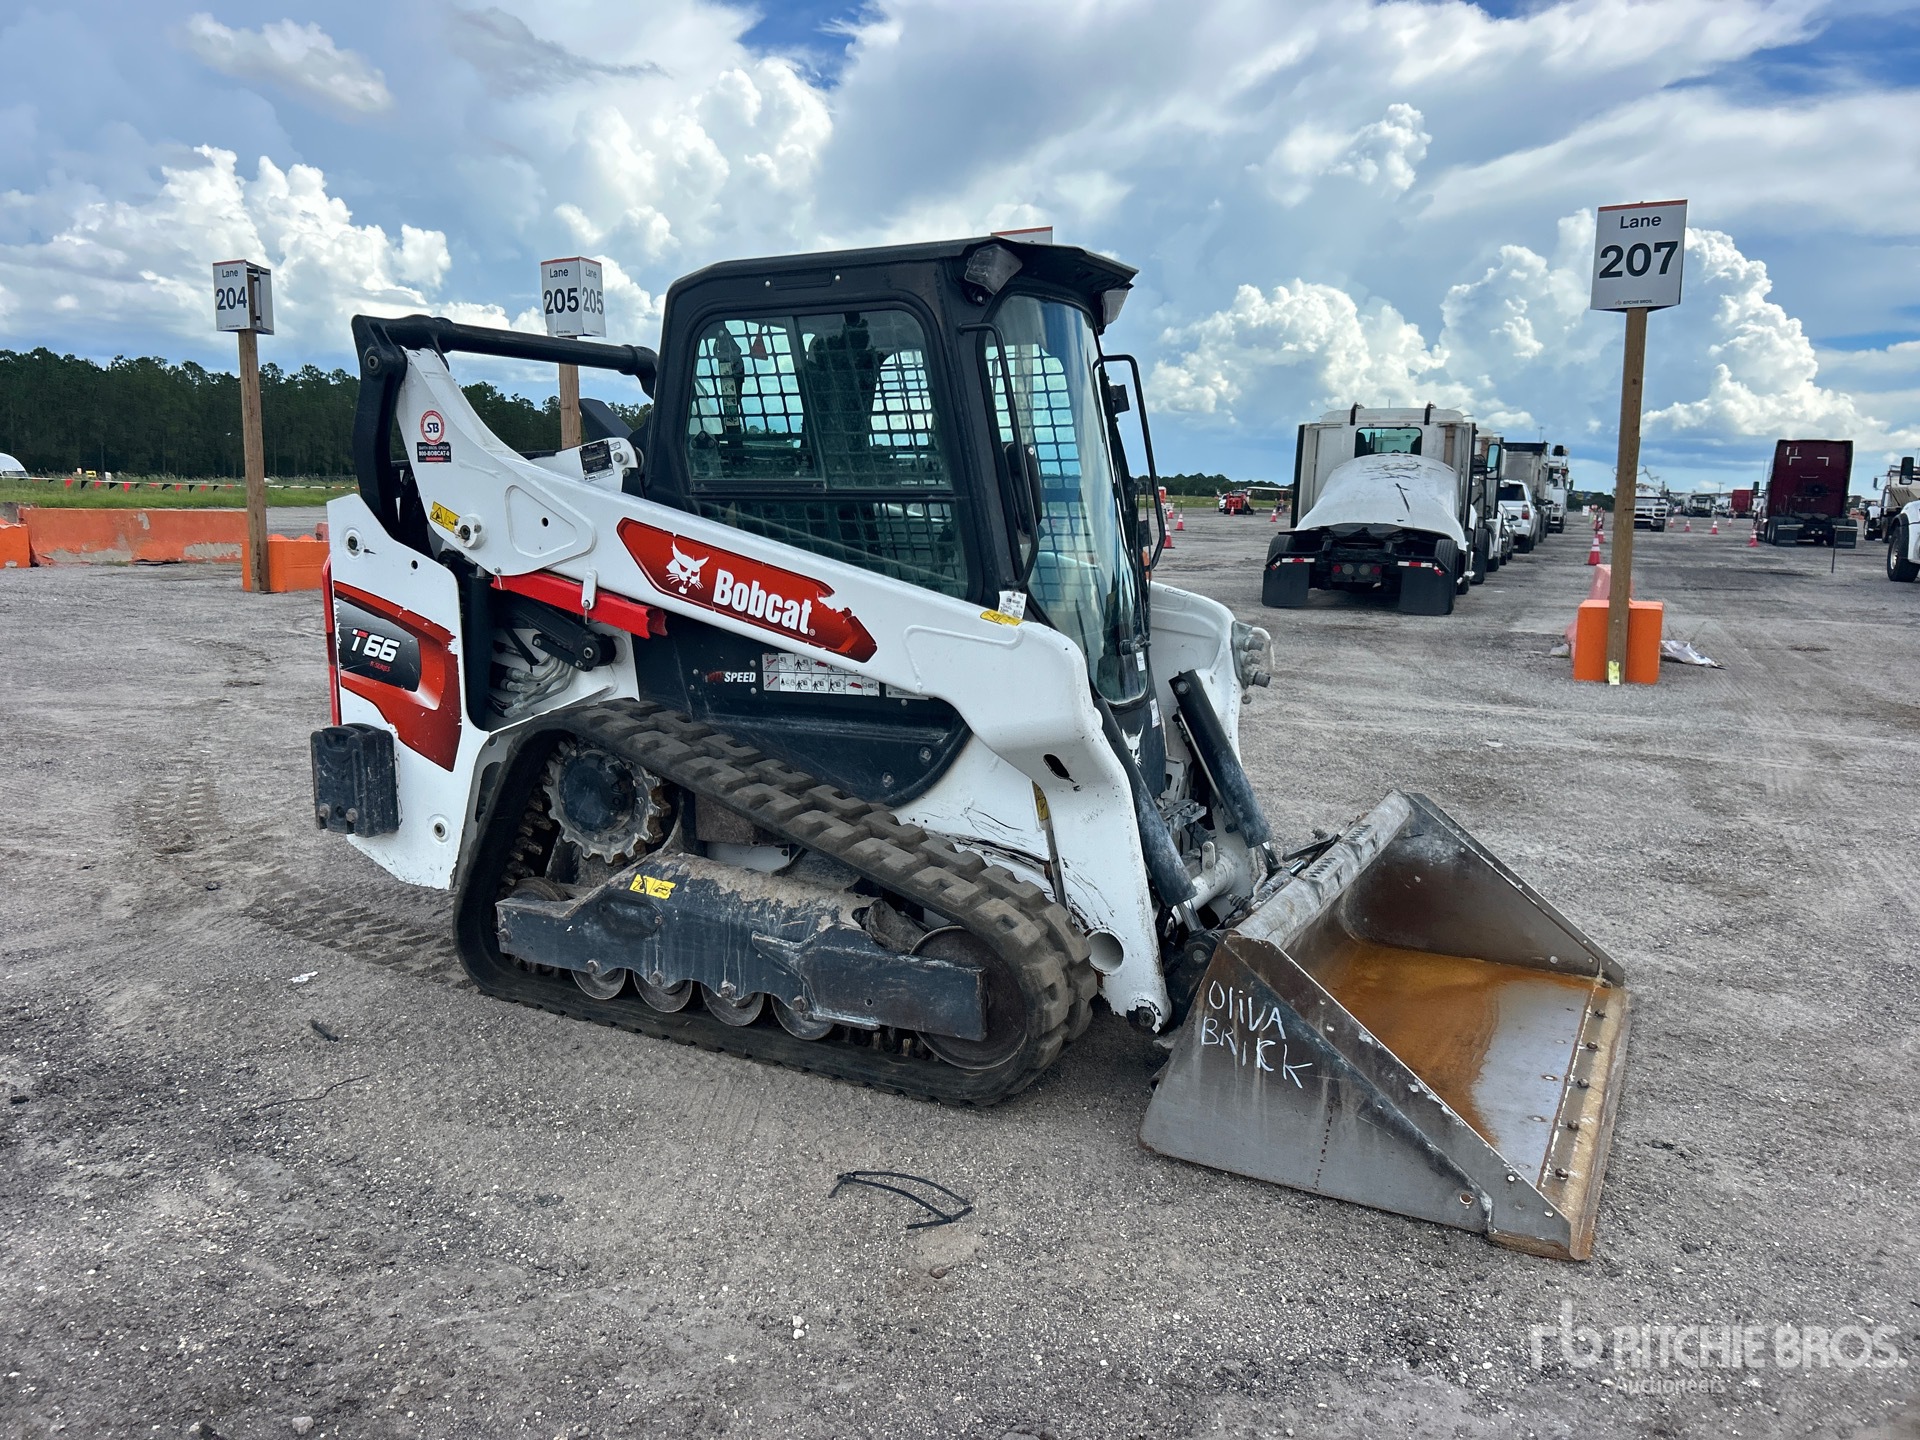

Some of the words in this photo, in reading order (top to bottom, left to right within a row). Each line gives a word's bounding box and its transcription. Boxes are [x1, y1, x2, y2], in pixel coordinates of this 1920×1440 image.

[1620, 215, 1662, 230] Lane
[1599, 241, 1678, 279] 207
[222, 269, 238, 278] Lane
[550, 268, 569, 278] Lane
[585, 266, 597, 279] Lane
[216, 286, 247, 310] 204
[544, 287, 579, 315] 205
[582, 286, 604, 315] 205
[712, 568, 812, 635] Bobcat
[724, 671, 756, 683] SPEED
